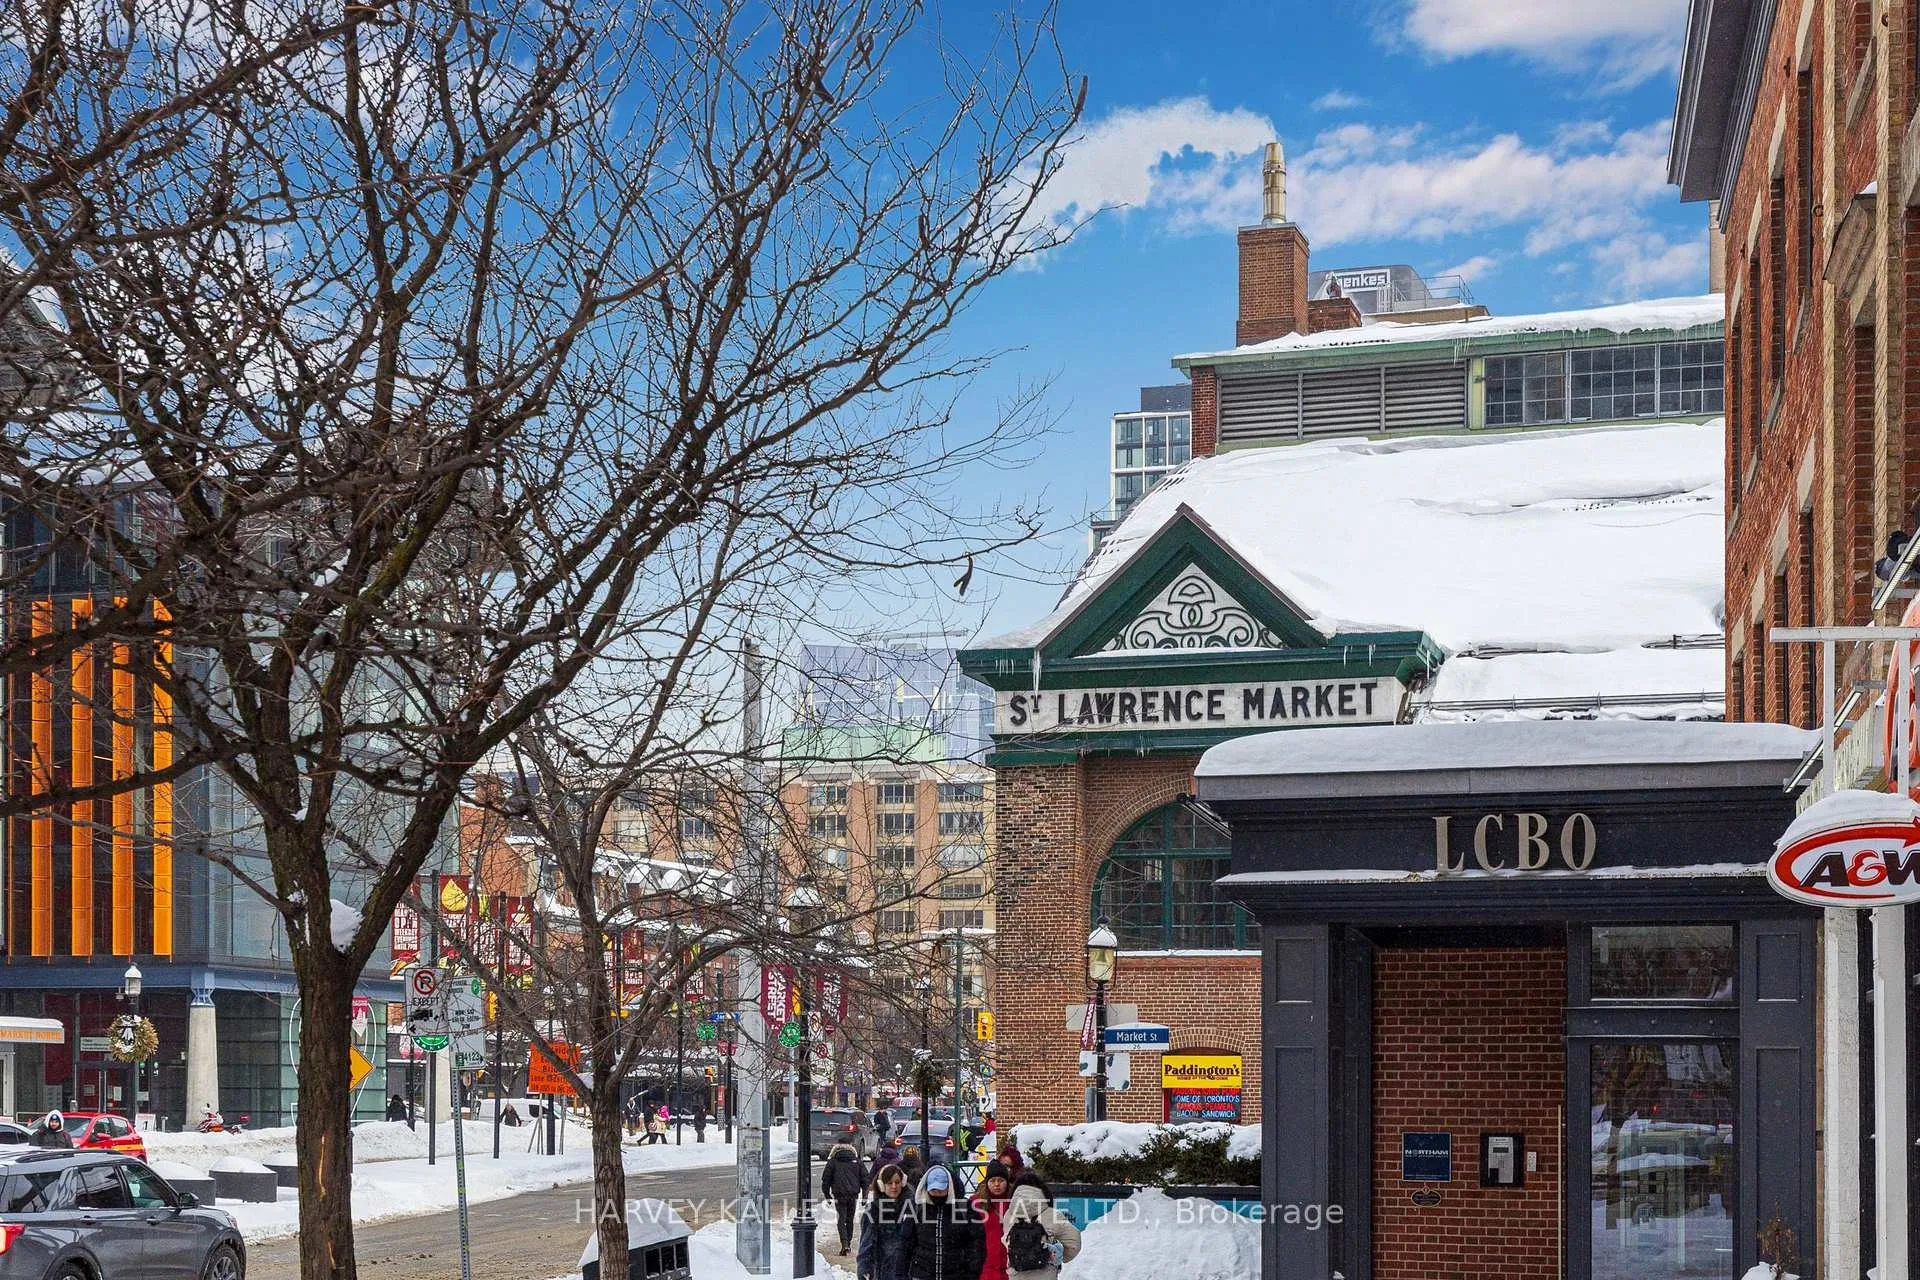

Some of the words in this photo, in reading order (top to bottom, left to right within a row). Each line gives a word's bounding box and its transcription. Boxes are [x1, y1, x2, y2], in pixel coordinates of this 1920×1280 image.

[1058, 689, 1226, 726] LAWRENCE
[1243, 683, 1378, 720] MARKET
[1432, 812, 1597, 874] LCBO
[1800, 850, 1920, 887] A&W
[1116, 1031, 1147, 1042] Market
[1150, 1032, 1158, 1041] St
[1164, 1064, 1240, 1080] Paddington's
[1204, 1095, 1240, 1103] TORONTO'S
[1202, 1109, 1236, 1118] SANDWICH
